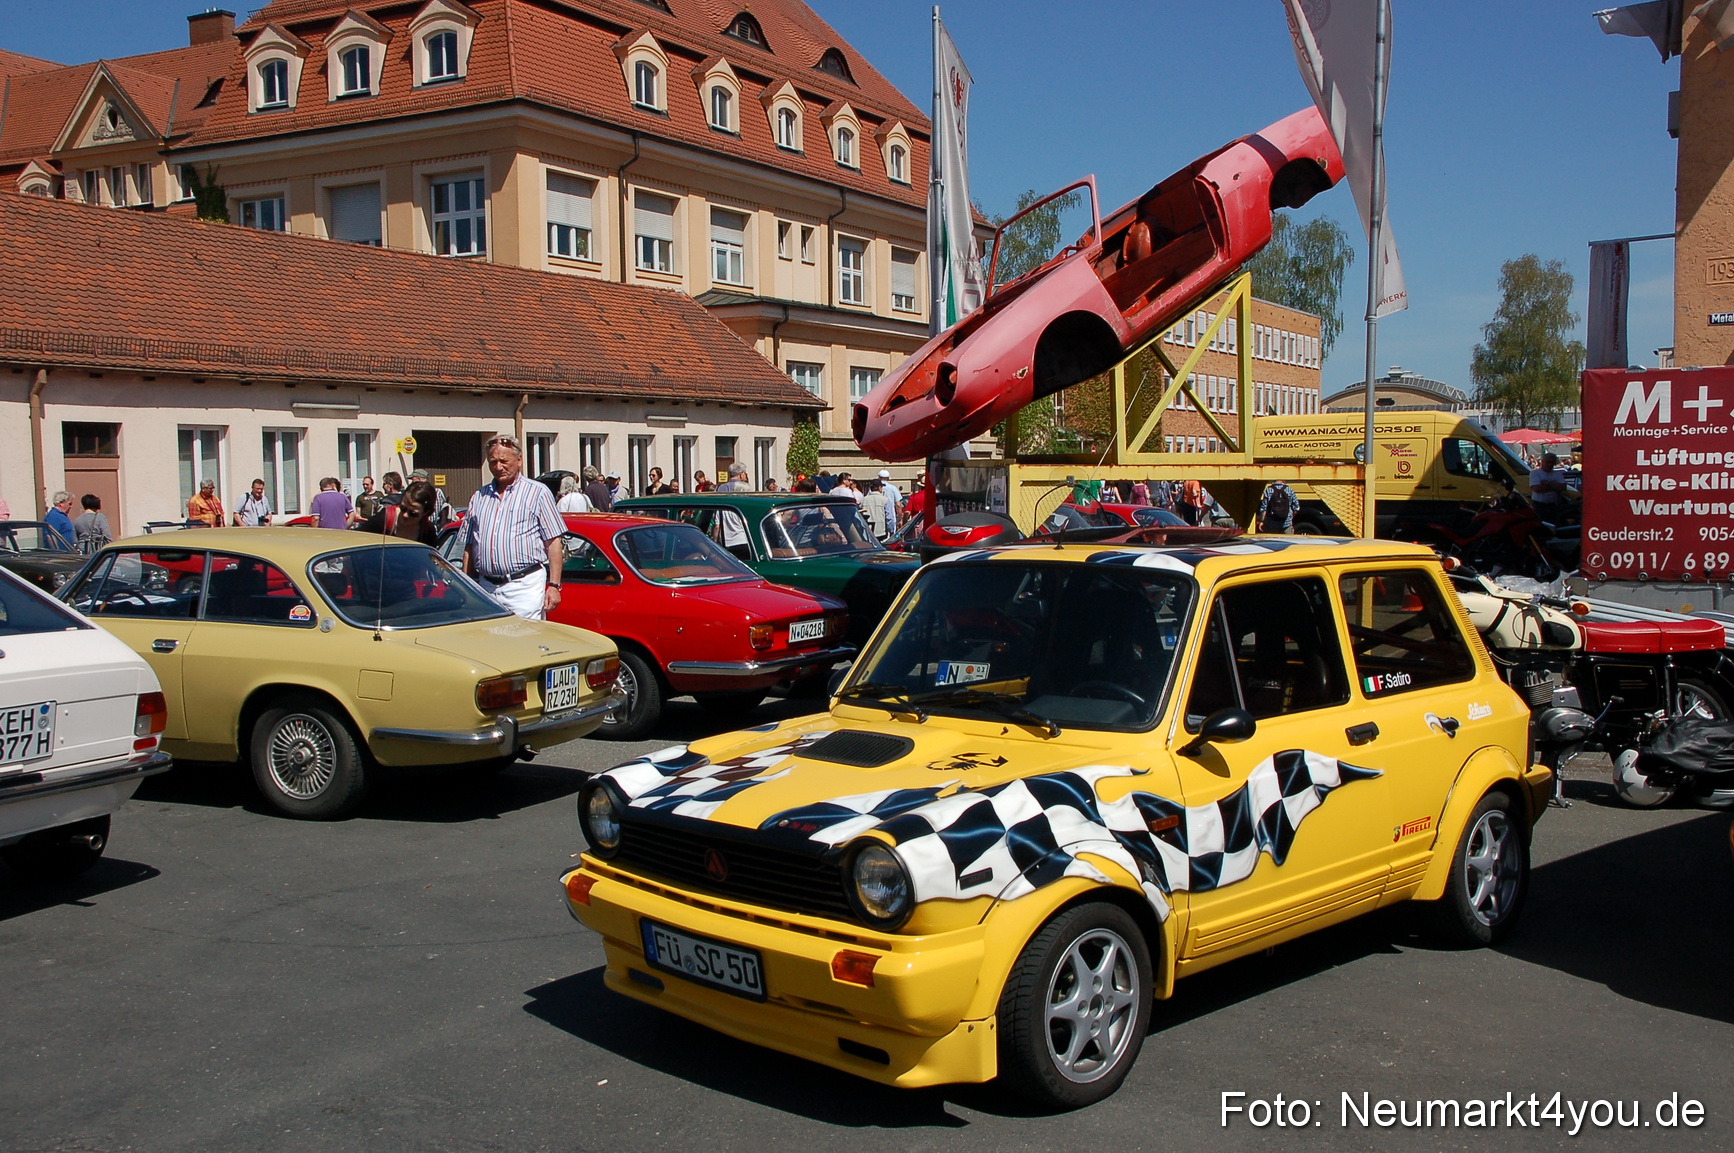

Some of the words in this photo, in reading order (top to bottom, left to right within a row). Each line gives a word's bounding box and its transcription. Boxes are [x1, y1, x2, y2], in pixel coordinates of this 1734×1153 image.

[1263, 426, 1422, 437] WWW.MANIACMOORS.DE
[1613, 424, 1728, 438] Montage+Service
[1606, 472, 1734, 491] Kälte-Kli
[553, 669, 570, 688] LAU
[946, 665, 959, 684] N
[547, 691, 558, 709] RZ
[560, 687, 577, 706] 23H
[1402, 816, 1431, 836] PIRELLI
[654, 930, 682, 967] FÜ
[694, 944, 724, 979] SC
[726, 952, 759, 989] 50
